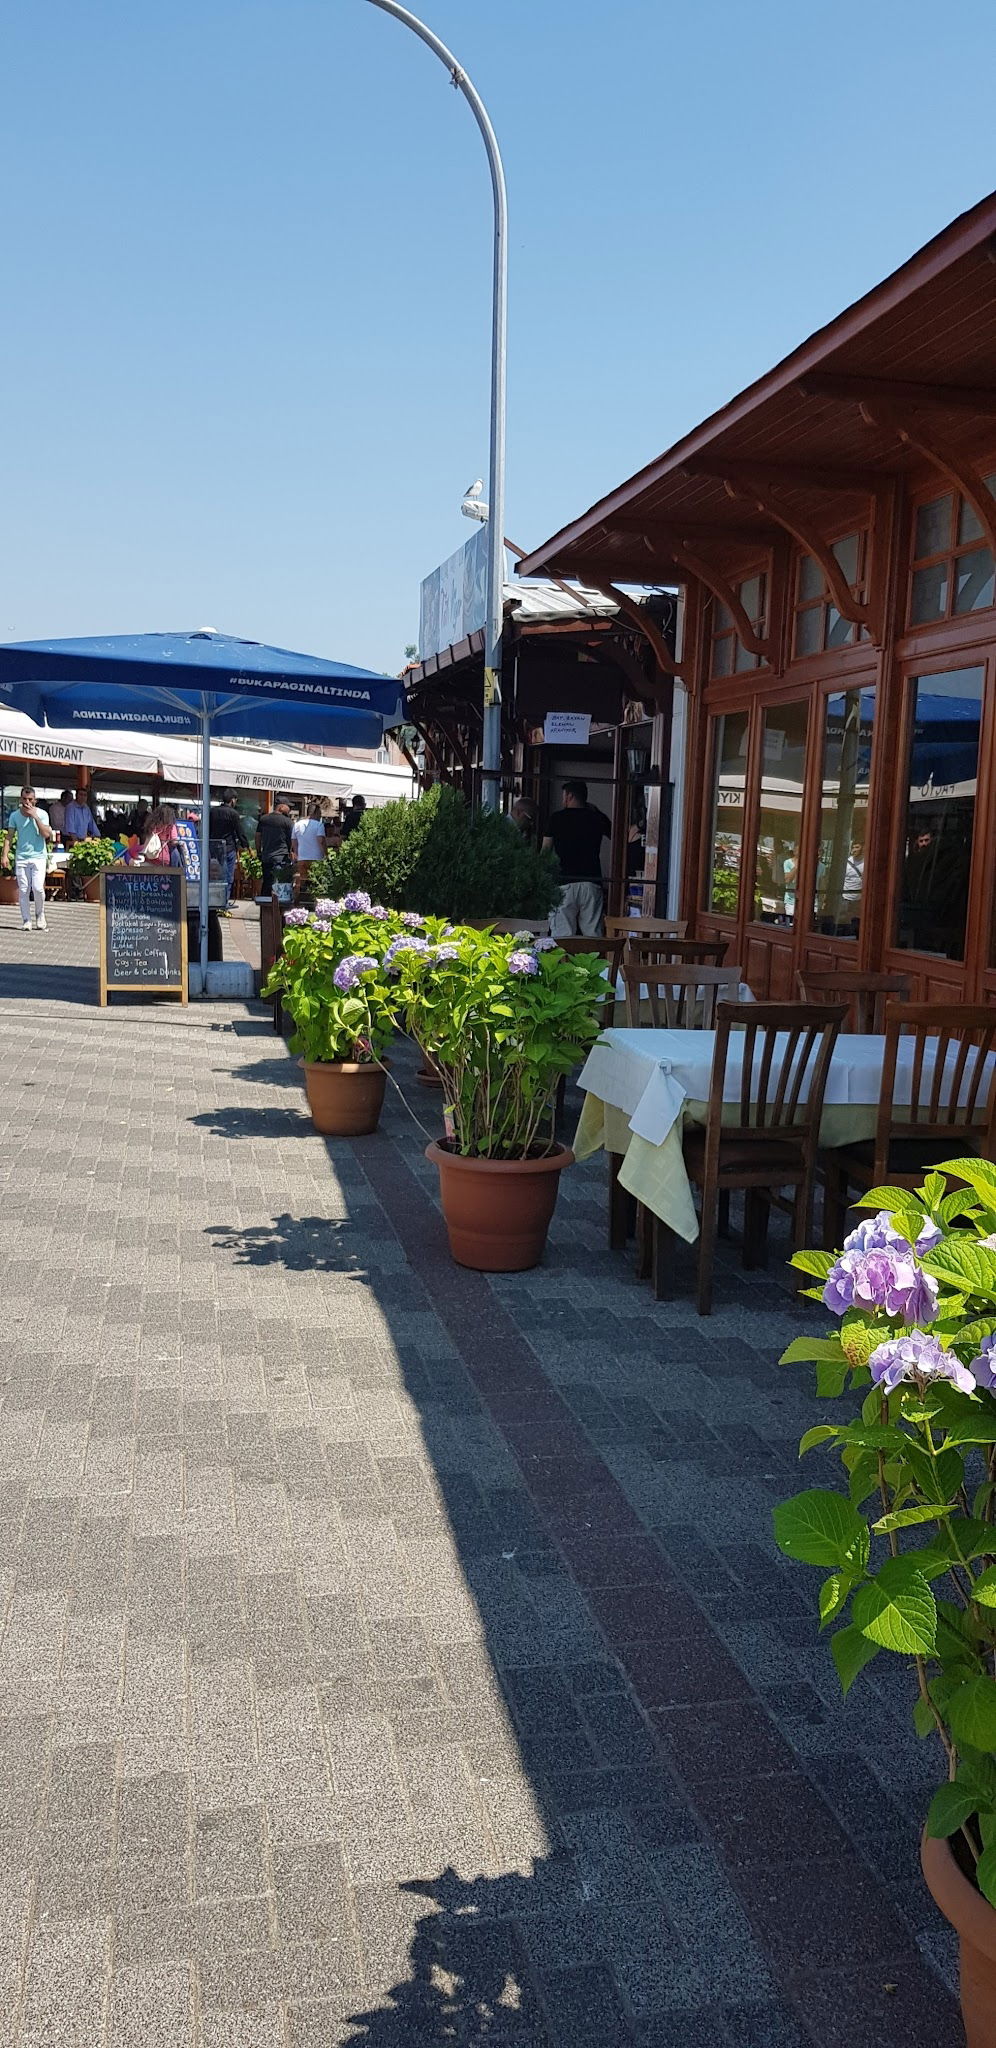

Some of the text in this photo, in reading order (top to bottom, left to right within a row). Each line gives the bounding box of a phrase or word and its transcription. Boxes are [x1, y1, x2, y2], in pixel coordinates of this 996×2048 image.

[22, 742, 84, 762] RESTAURANT
[235, 773, 296, 790] KIYI RESTAURANT
[126, 881, 159, 892] TERAS
[112, 949, 142, 958] Turkish
[134, 958, 148, 967] Tea
[114, 968, 132, 977] Beer
[142, 968, 158, 976] Cold
